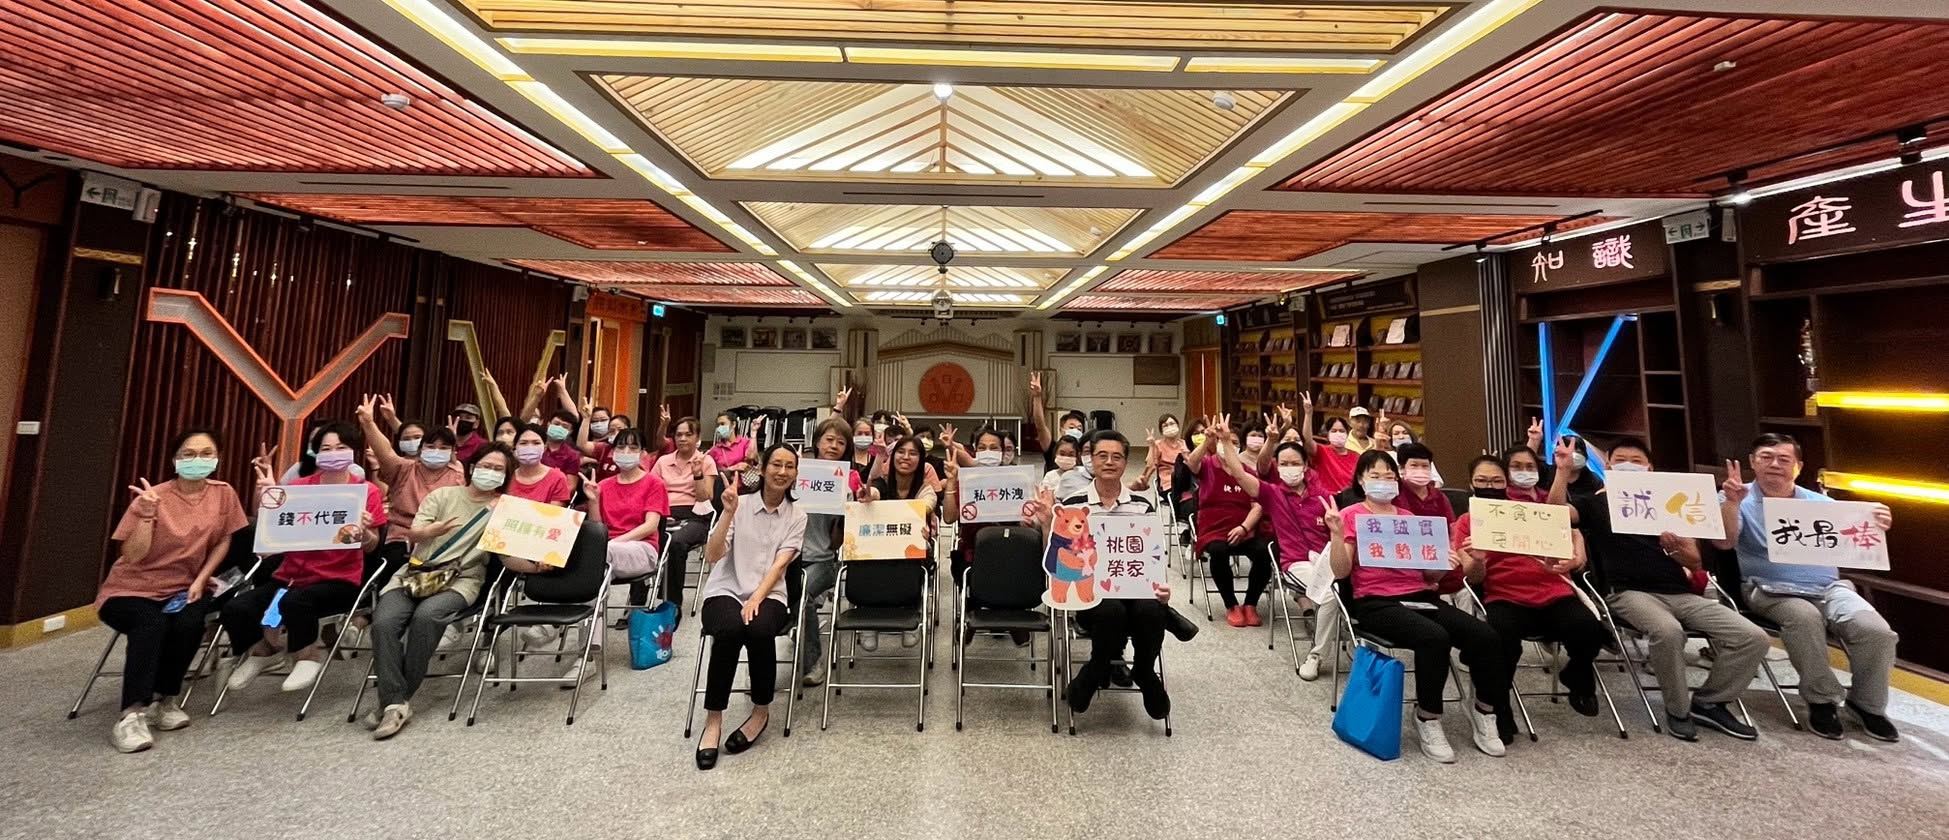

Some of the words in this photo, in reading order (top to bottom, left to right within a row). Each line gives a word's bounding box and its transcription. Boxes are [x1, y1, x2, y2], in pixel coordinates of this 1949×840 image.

[1531, 234, 1634, 283] 知識
[973, 487, 1024, 502] 私不外洩
[1488, 503, 1551, 522] 不貪心
[1618, 488, 1706, 525] 誠信
[278, 510, 348, 526] 錢不代管
[859, 523, 912, 537] 廉潔無礙
[1771, 517, 1881, 550] 我最棒
[1106, 535, 1144, 554] 桃園
[1107, 559, 1145, 578] 榮家
